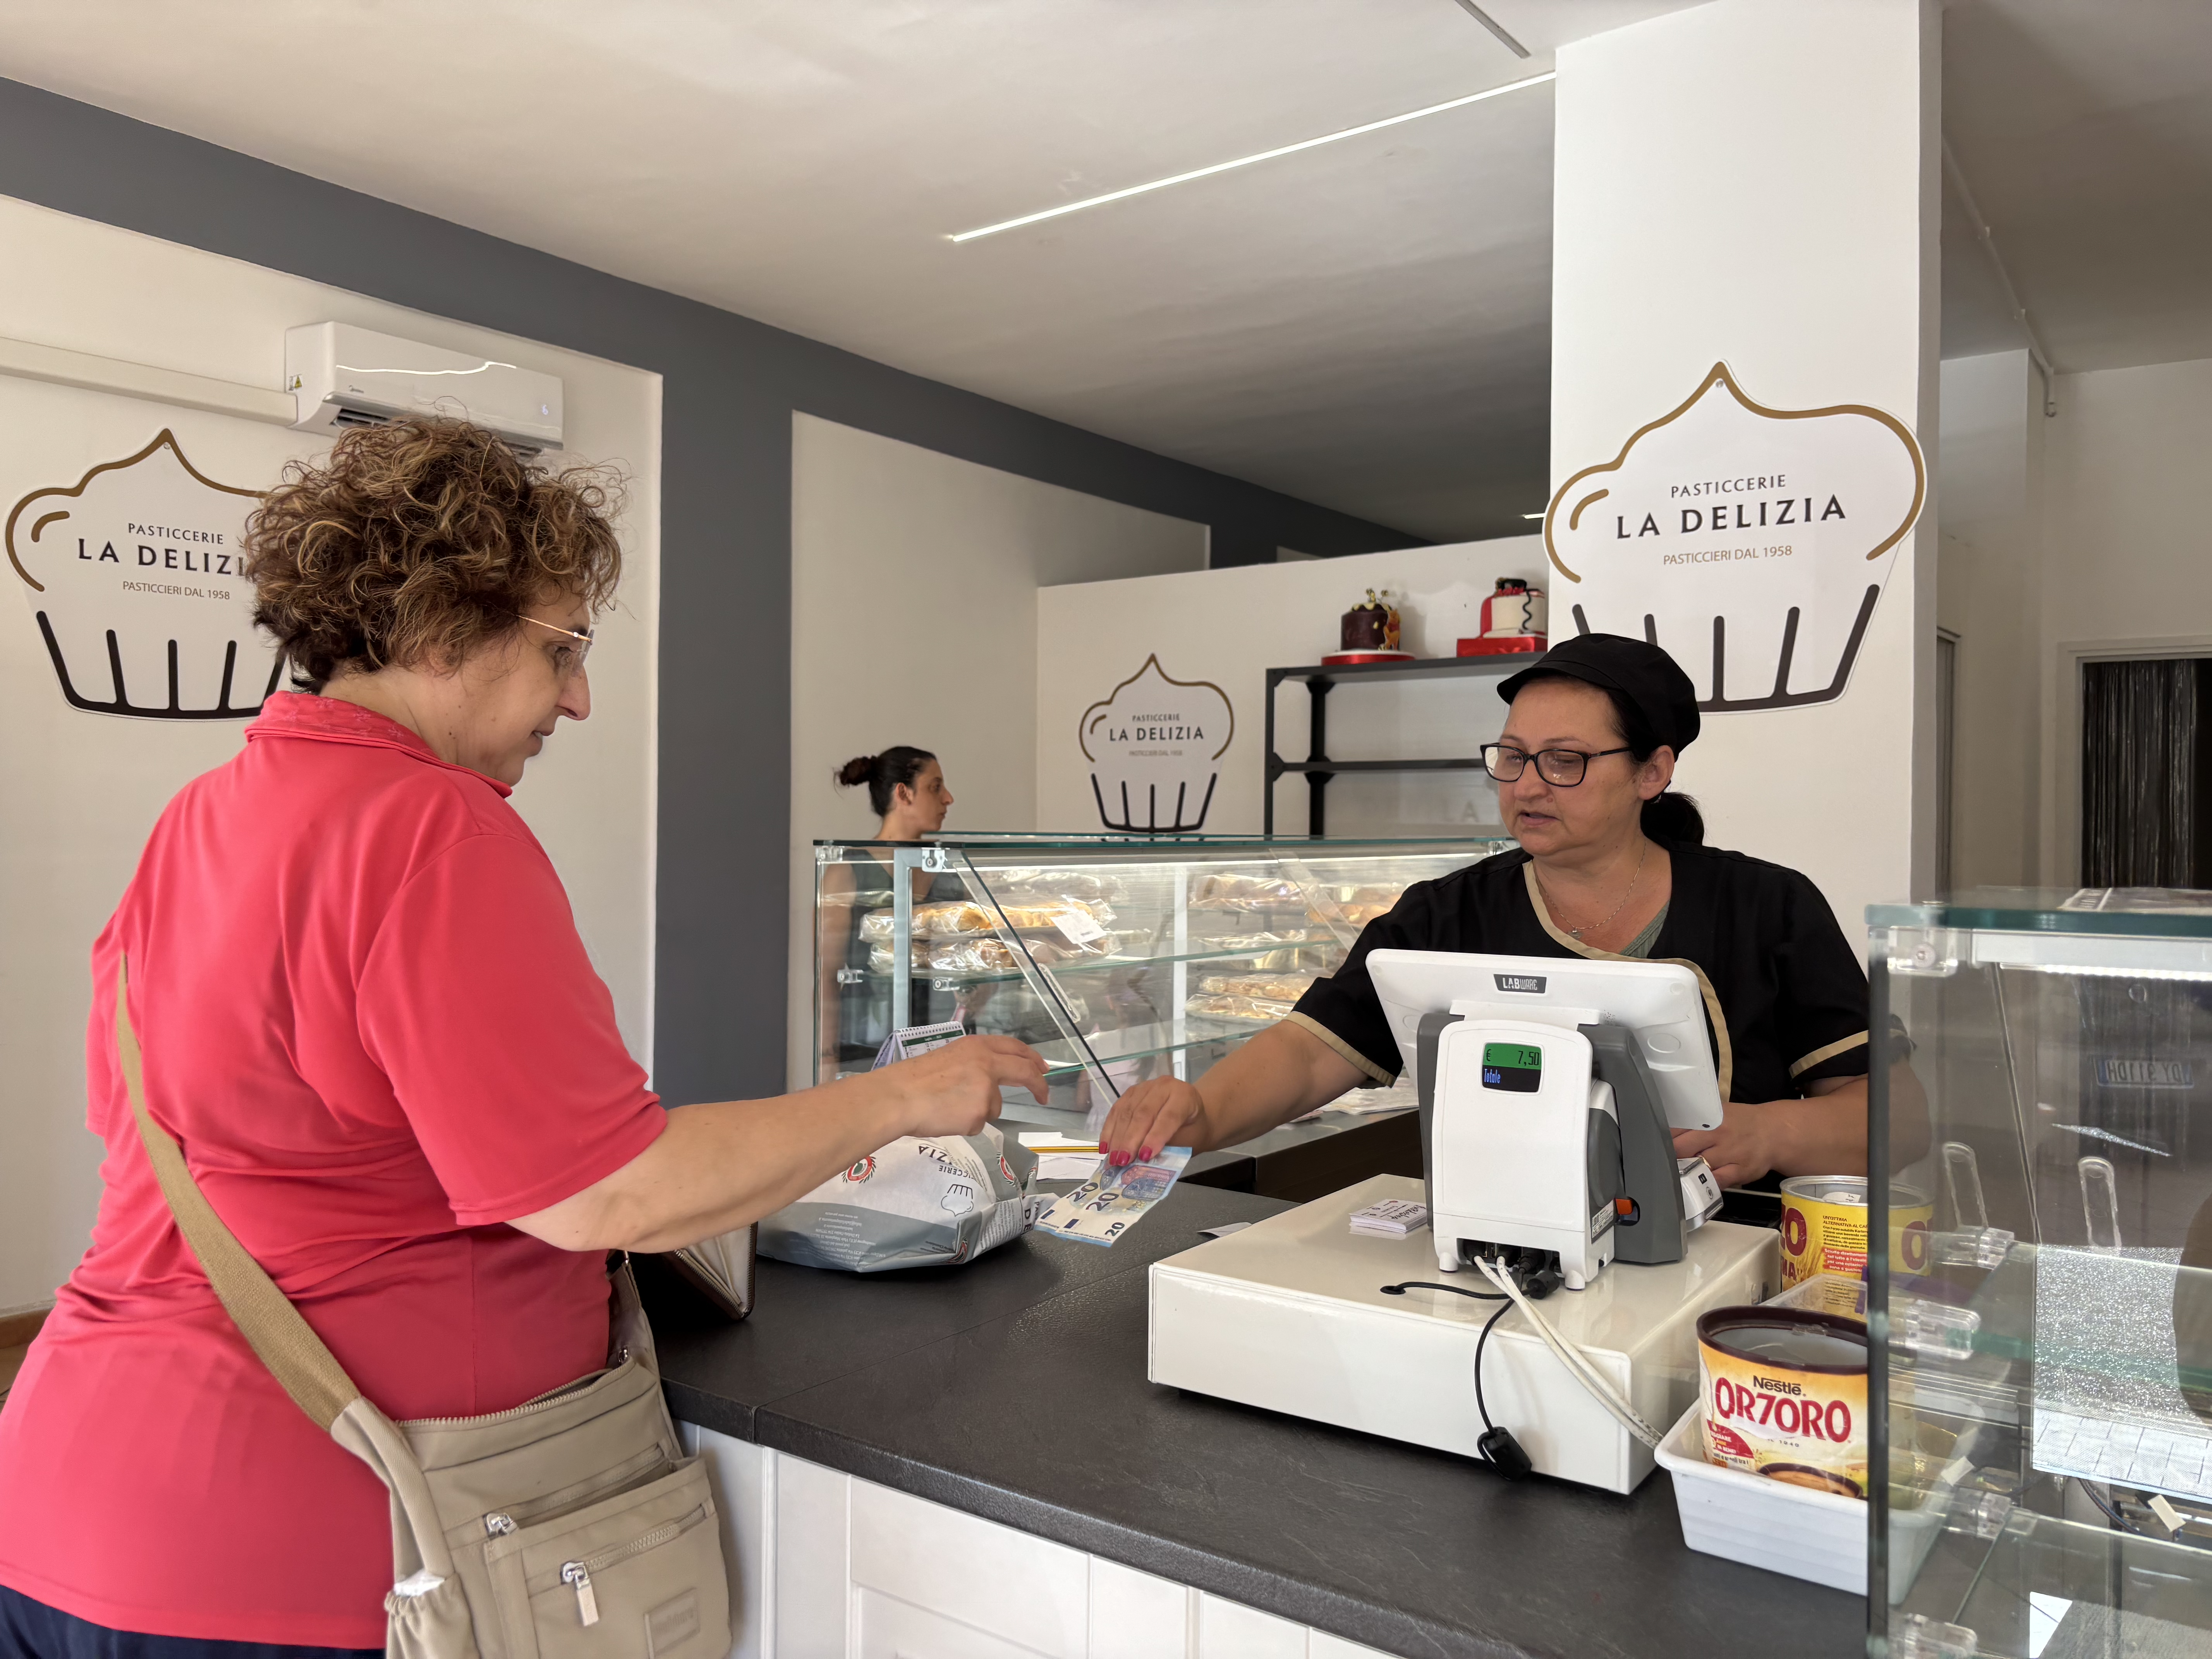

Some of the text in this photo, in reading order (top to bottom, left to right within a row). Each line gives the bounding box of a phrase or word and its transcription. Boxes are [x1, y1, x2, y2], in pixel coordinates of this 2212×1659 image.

[1671, 474, 1786, 498] PASTICCERIE
[1617, 494, 1846, 539] LA DELIZIA
[128, 523, 223, 544] PASTICCERIE
[79, 538, 245, 577] LA DELIZI
[1664, 545, 1792, 565] PASTICCIERI DAL 1958
[123, 581, 230, 599] PASTICCIERI DAL 1958
[1132, 713, 1180, 722] PASTICCERIE
[1109, 726, 1204, 741] LA DELIZIA
[1503, 977, 1537, 991] LABWARE
[1486, 1049, 1540, 1066] € 7,50
[1484, 1068, 1501, 1084] Totale
[1066, 1182, 1098, 1202] 20
[1085, 1193, 1119, 1211] 20
[1104, 1222, 1125, 1237] 20
